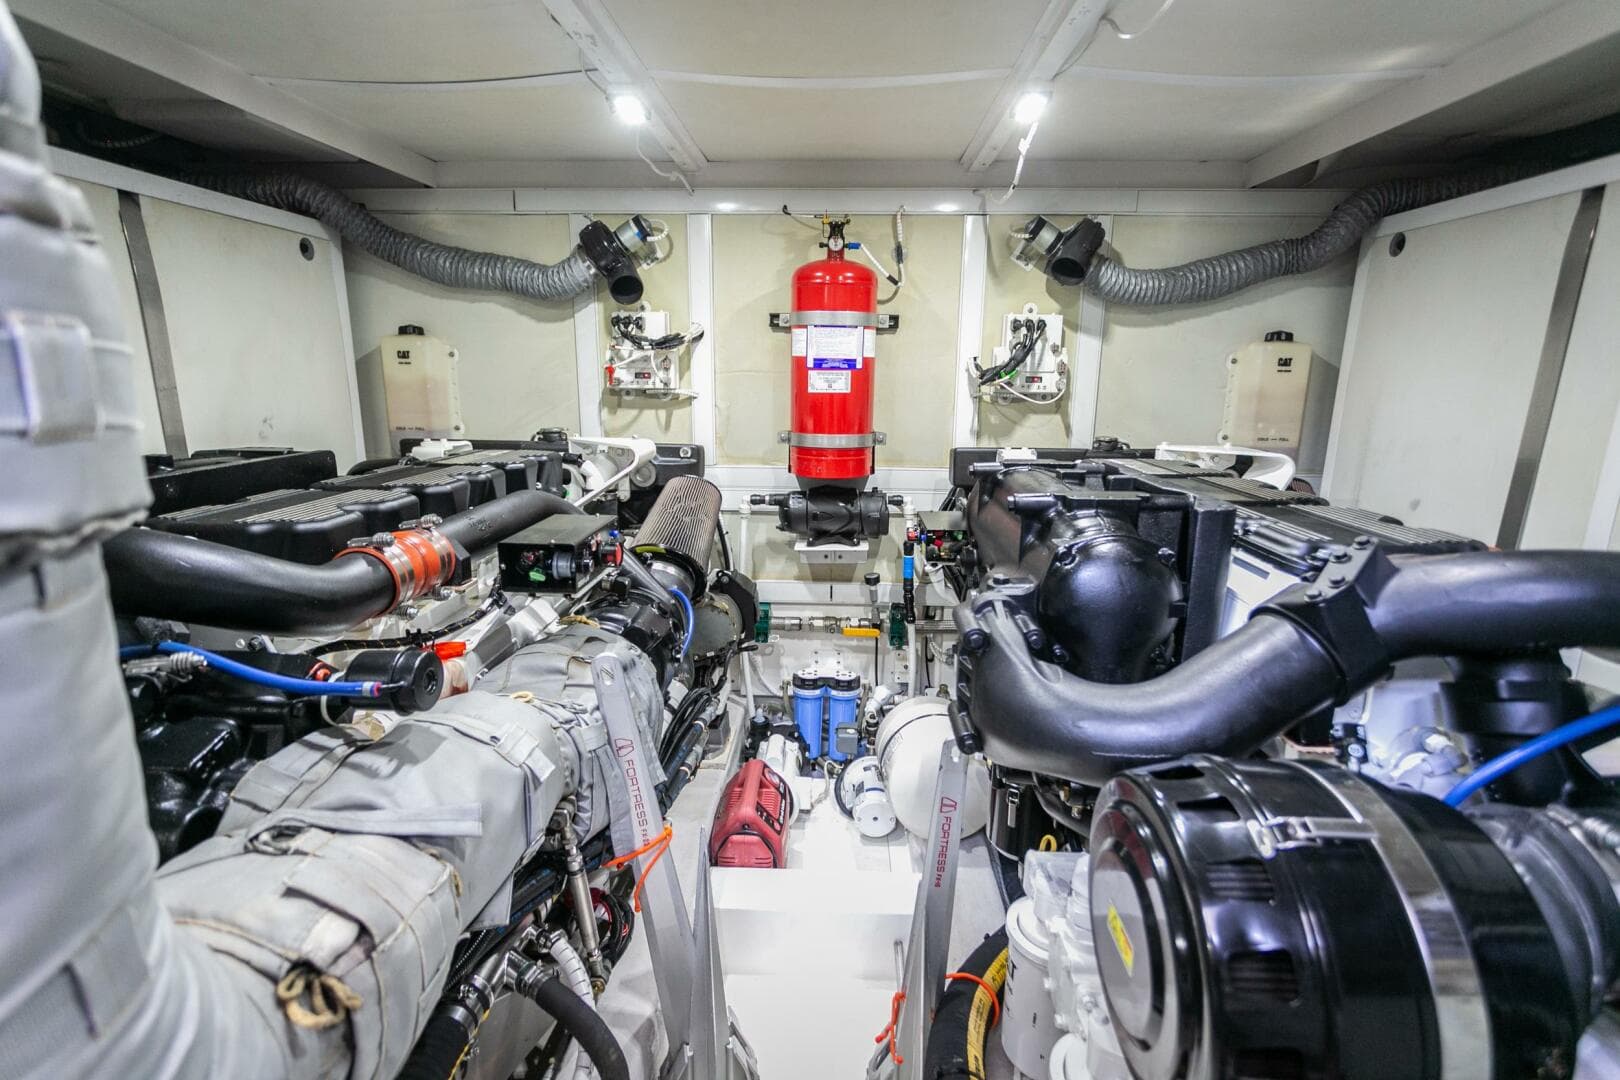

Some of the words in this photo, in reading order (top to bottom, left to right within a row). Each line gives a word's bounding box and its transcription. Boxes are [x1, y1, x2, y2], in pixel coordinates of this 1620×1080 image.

[397, 350, 410, 359] CAT
[1277, 357, 1293, 367] CAT
[624, 759, 649, 827] FORTRESS
[936, 815, 952, 873] FORTRESS
